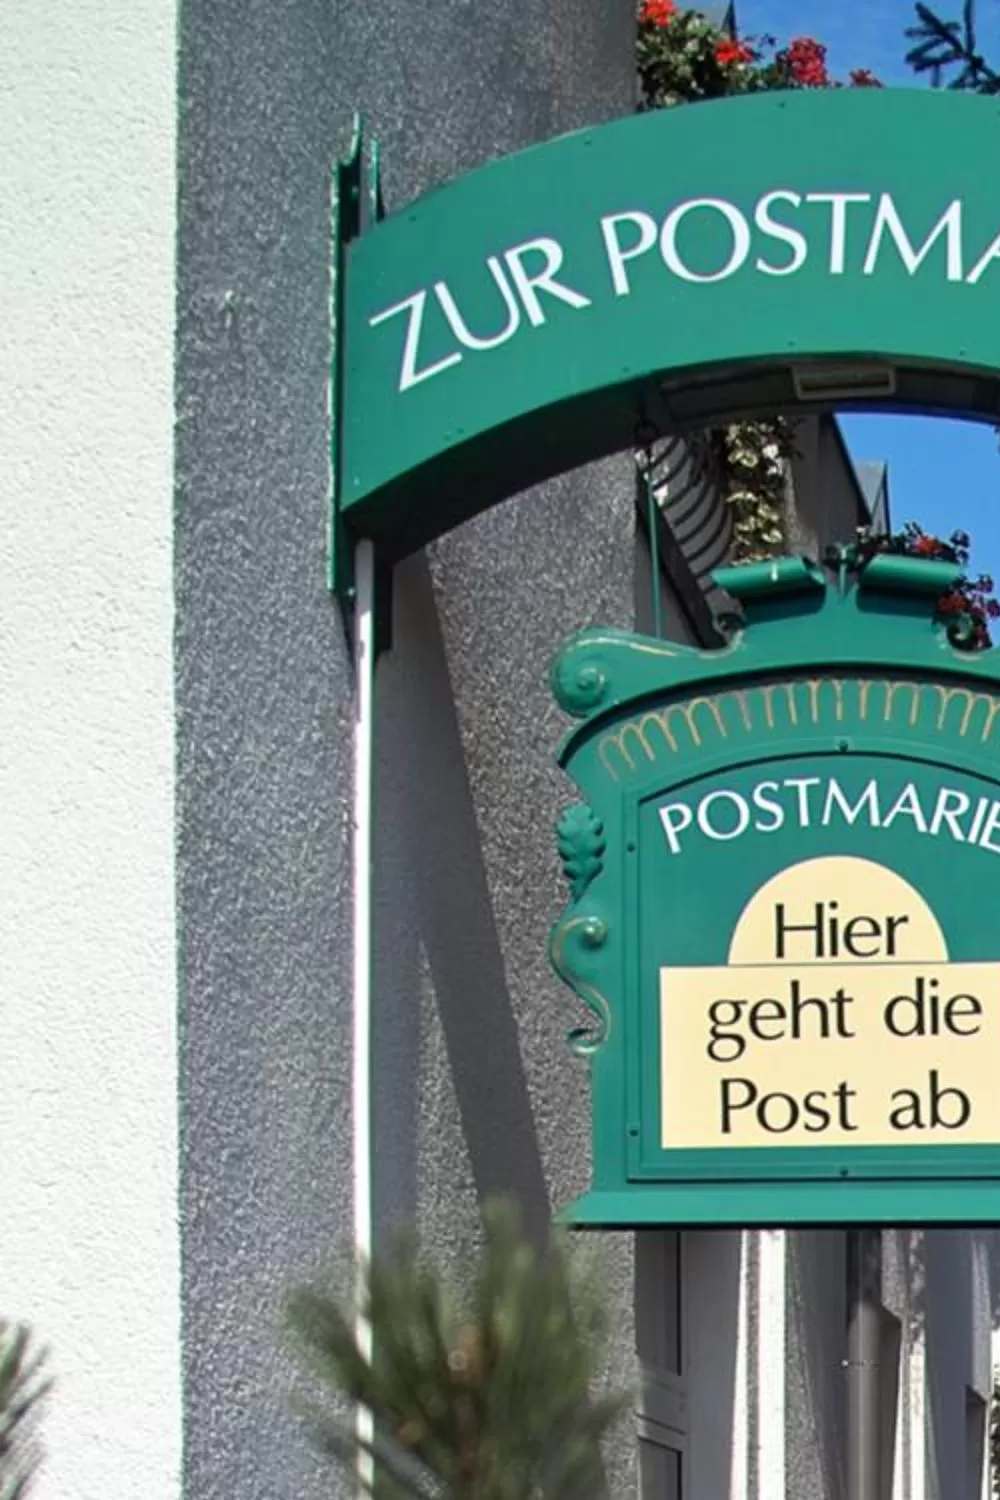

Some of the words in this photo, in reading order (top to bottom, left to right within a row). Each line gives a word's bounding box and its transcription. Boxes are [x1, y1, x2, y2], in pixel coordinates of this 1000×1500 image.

[369, 237, 591, 393] ZUR
[774, 901, 910, 960] Hier
[706, 979, 855, 1063] geht
[884, 977, 983, 1037] die
[721, 1077, 858, 1135] Post
[888, 1069, 972, 1130] ab
